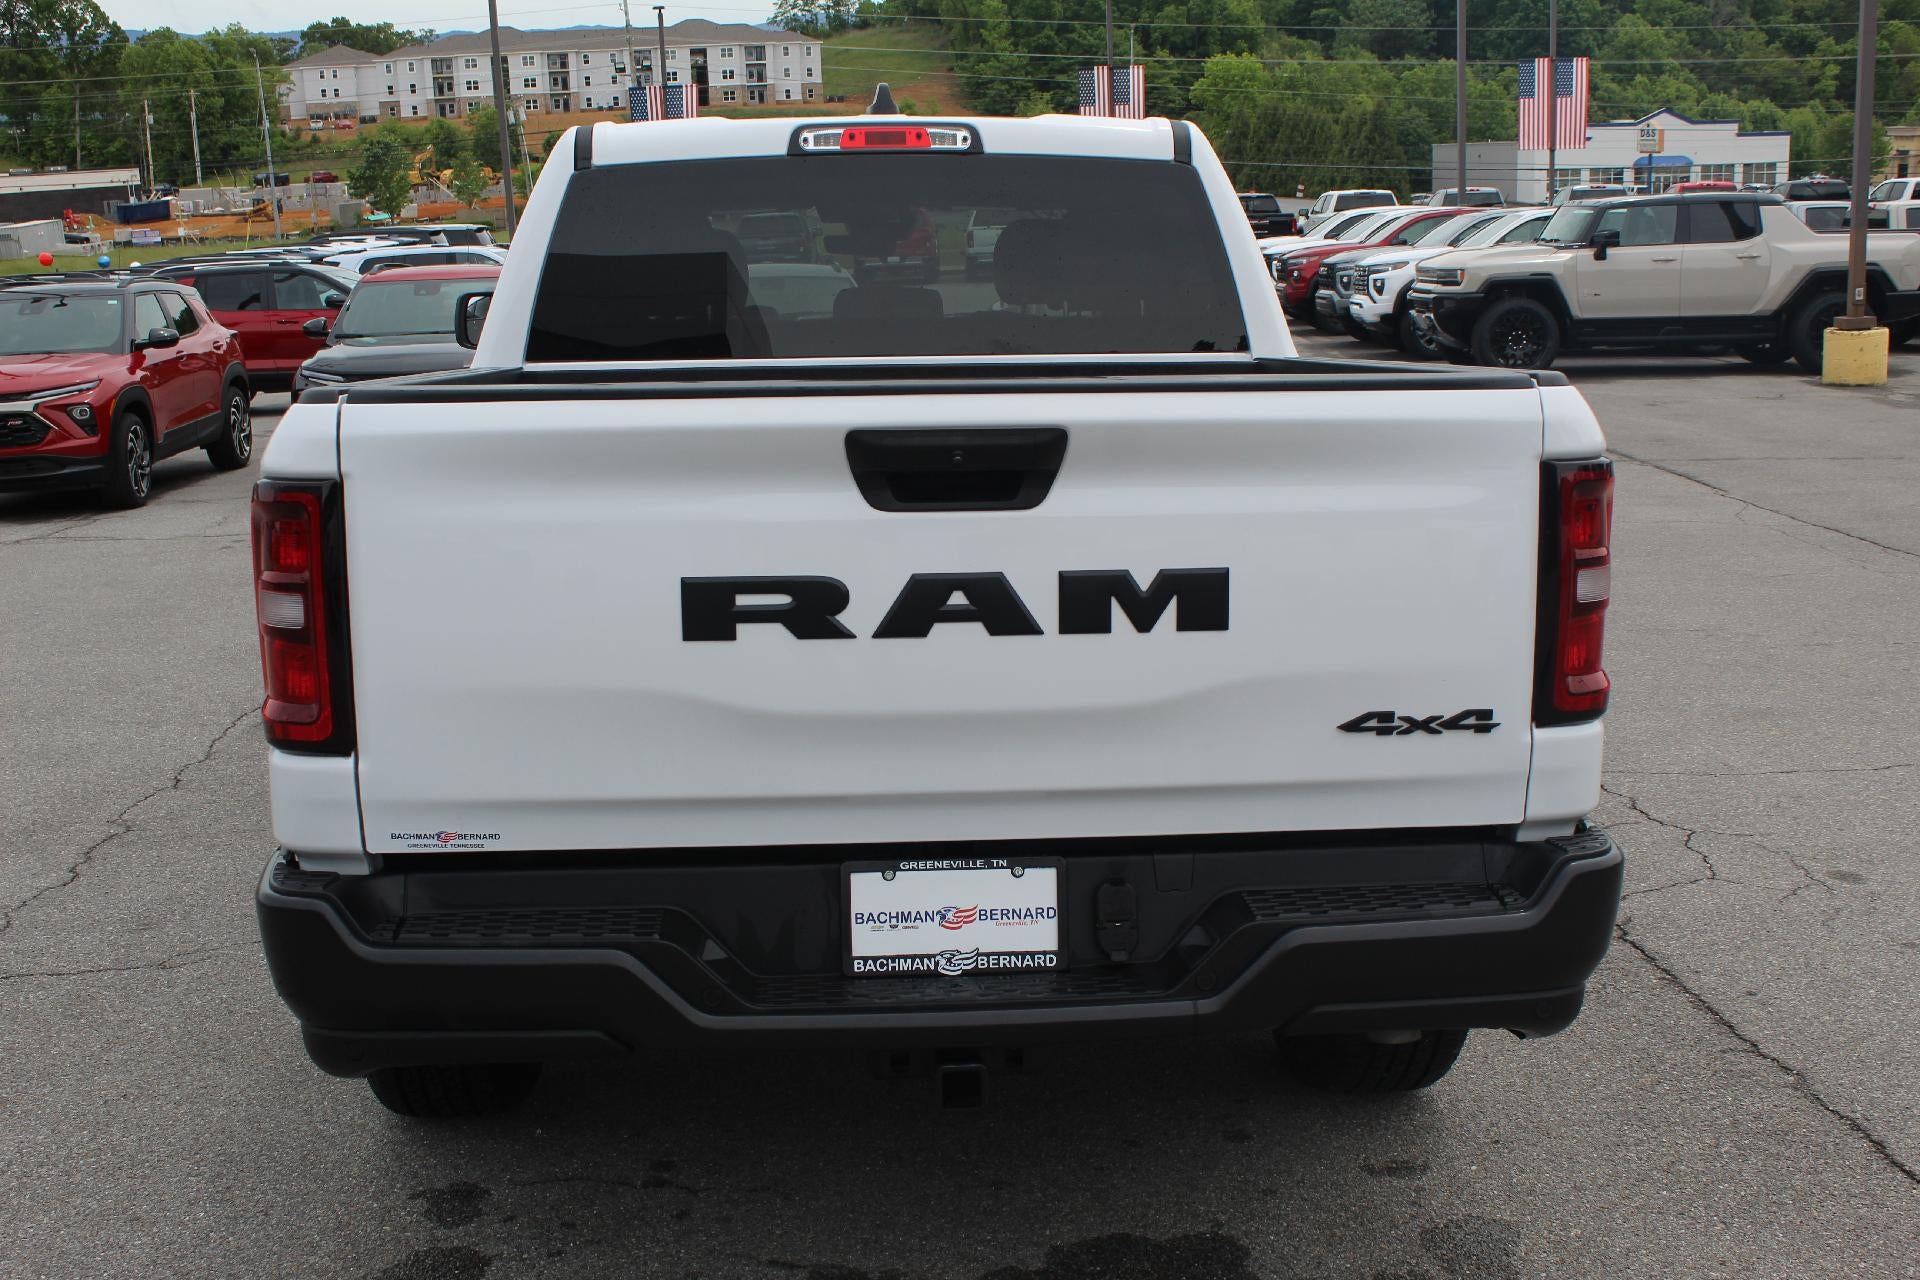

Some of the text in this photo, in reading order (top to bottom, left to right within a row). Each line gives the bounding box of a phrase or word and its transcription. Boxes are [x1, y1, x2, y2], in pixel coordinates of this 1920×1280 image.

[681, 567, 1229, 641] RAM
[1336, 708, 1502, 736] 4x4
[391, 832, 500, 840] BACHMAN BERNARD
[900, 858, 1008, 869] GREENEVILLE, TN
[855, 906, 1056, 925] BACHMAN BERNARD
[853, 954, 1058, 973] BACHMAN BERNARD
